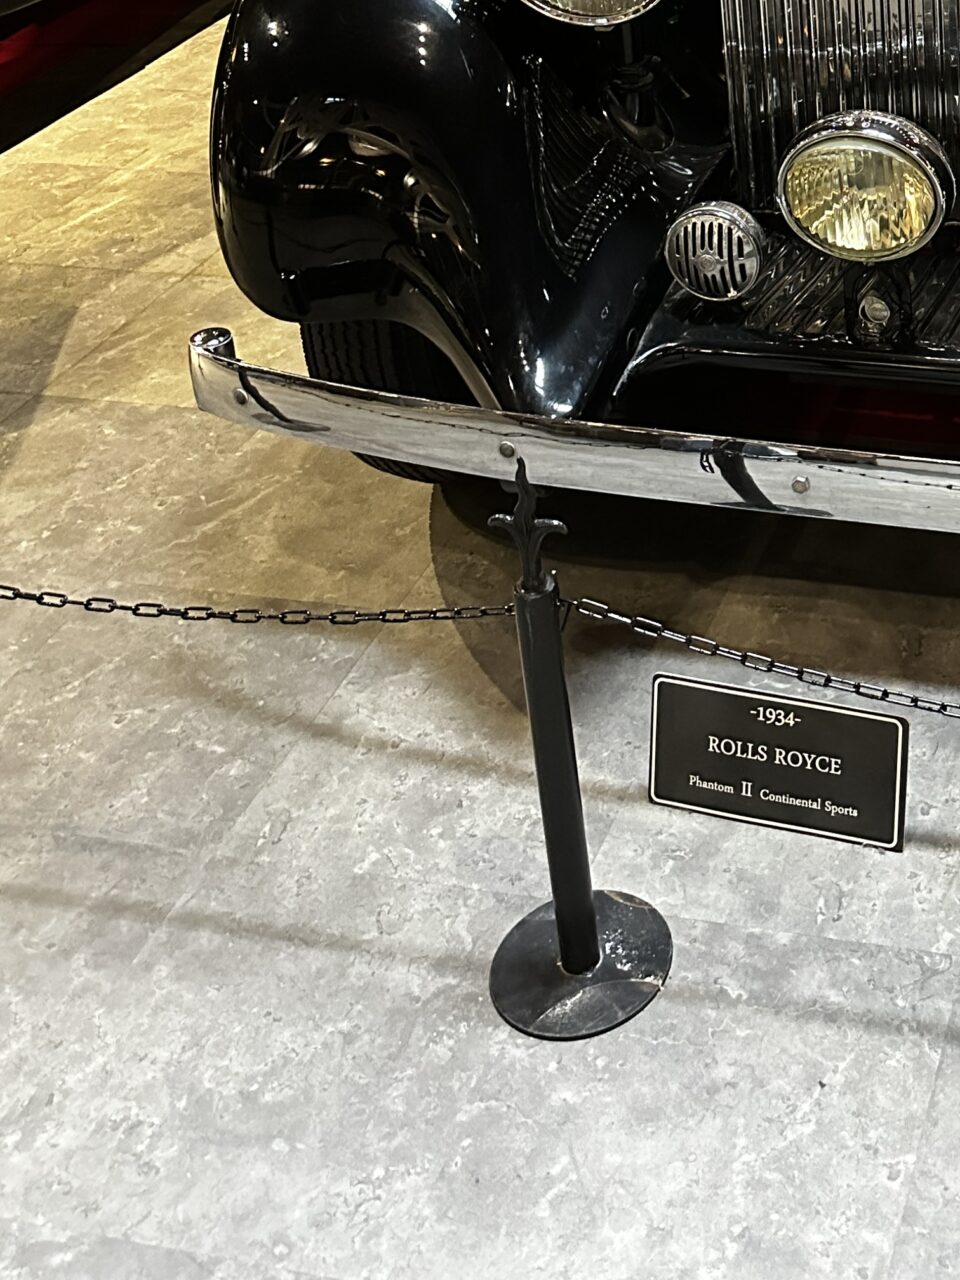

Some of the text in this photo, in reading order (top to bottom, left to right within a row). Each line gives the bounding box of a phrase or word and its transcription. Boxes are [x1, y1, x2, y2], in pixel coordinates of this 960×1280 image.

[750, 706, 802, 727] -1934-
[707, 735, 842, 775] ROLLS ROYCE
[689, 774, 858, 817] Phantom II Continental Sports
